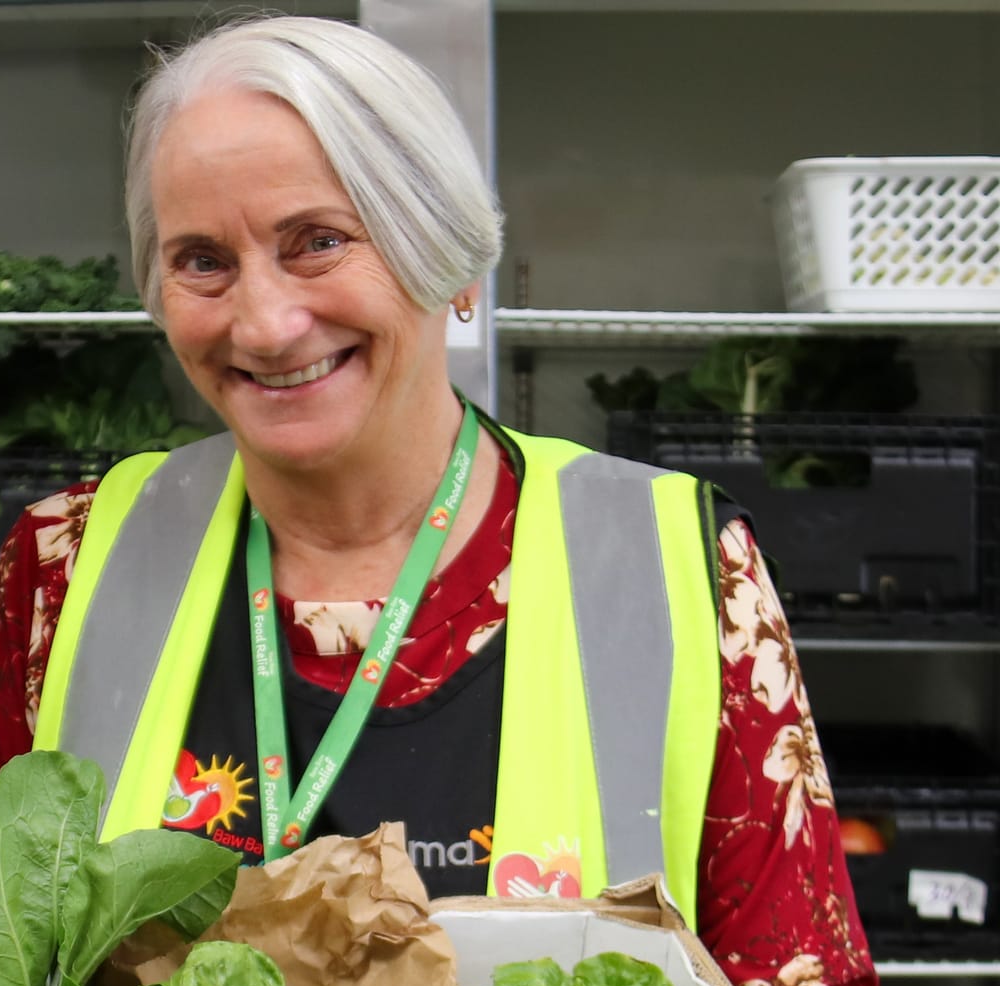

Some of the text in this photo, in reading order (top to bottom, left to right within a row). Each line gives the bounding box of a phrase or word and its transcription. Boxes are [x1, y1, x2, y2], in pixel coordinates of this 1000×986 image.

[453, 453, 471, 485] Relief
[445, 480, 464, 510] Food
[254, 615, 269, 677] Food Relief
[377, 632, 397, 663] Food
[390, 599, 411, 636] Relief
[264, 782, 278, 811] Food
[297, 791, 320, 822] Food
[312, 756, 336, 792] Relief
[212, 828, 262, 856] Baw Ba
